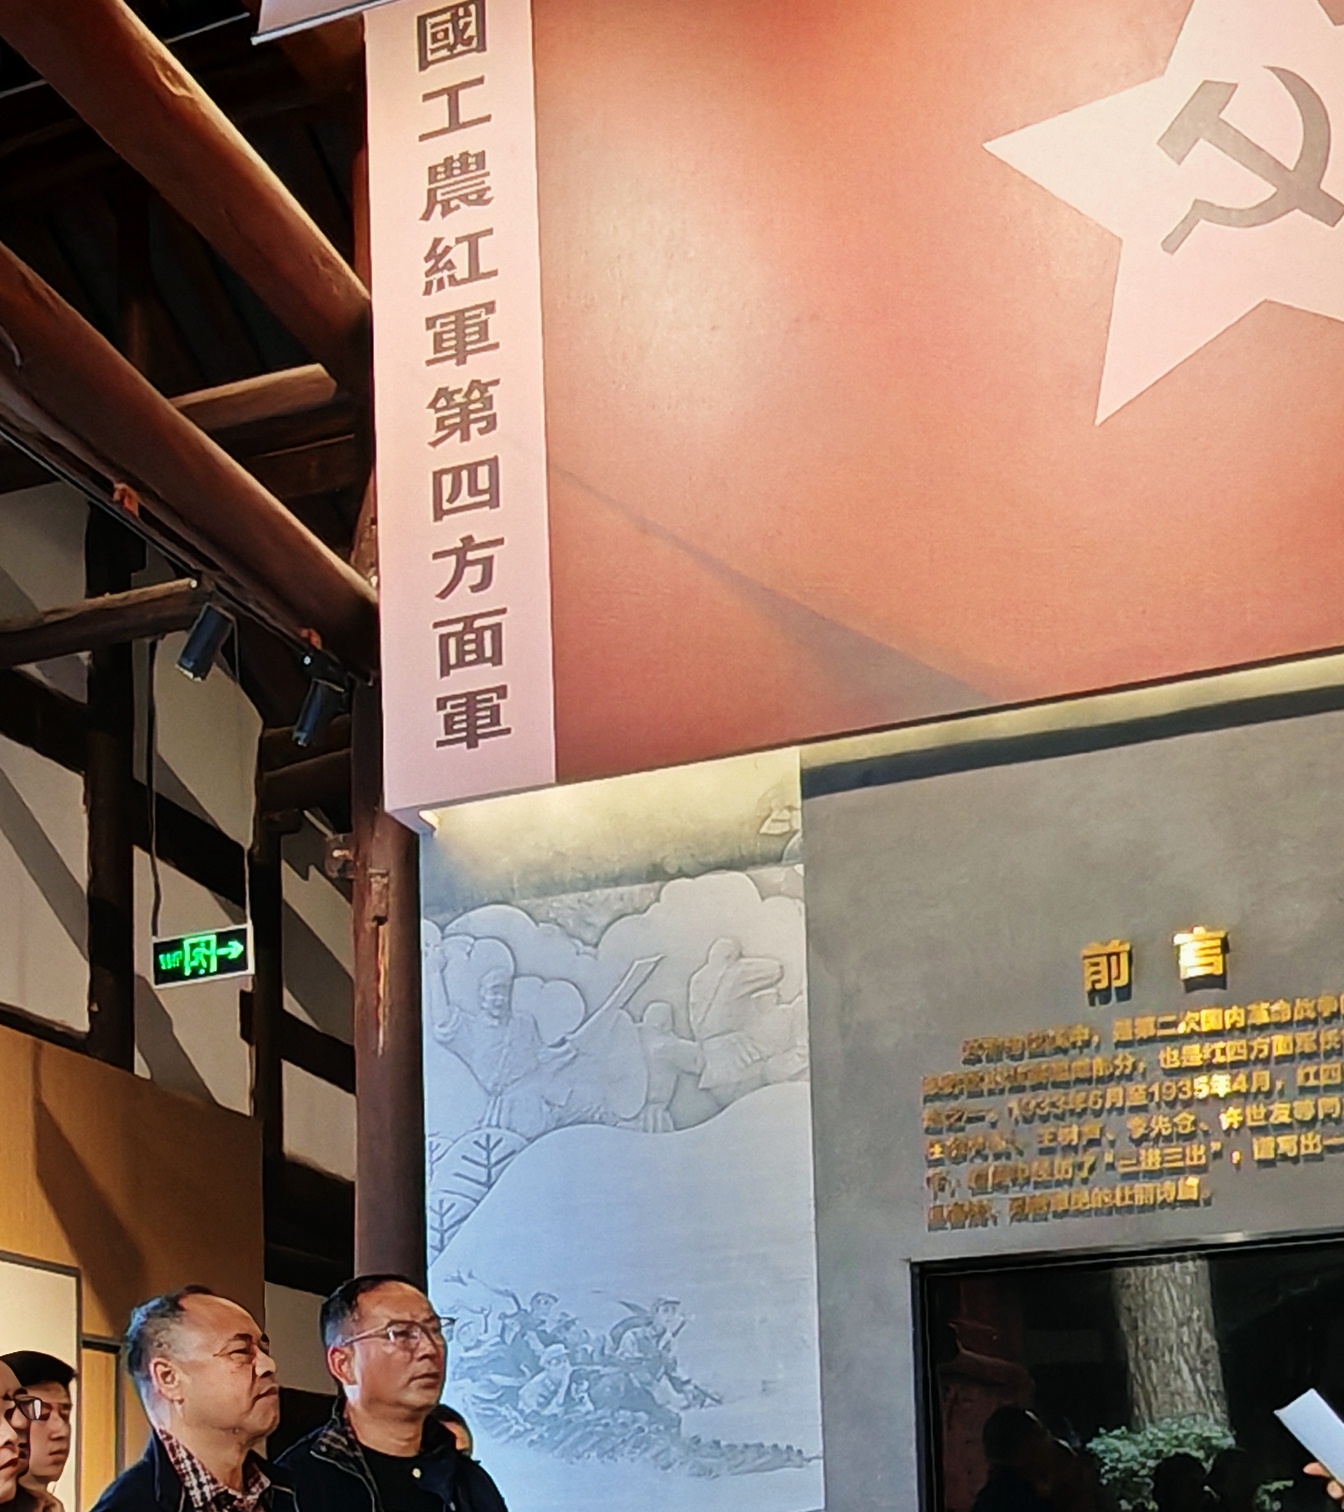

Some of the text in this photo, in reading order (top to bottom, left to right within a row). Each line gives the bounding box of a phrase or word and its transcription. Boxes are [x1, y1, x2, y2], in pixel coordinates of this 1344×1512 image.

[415, 0, 513, 751] 國工農紅軍第四方面軍
[1081, 926, 1228, 994] 前言
